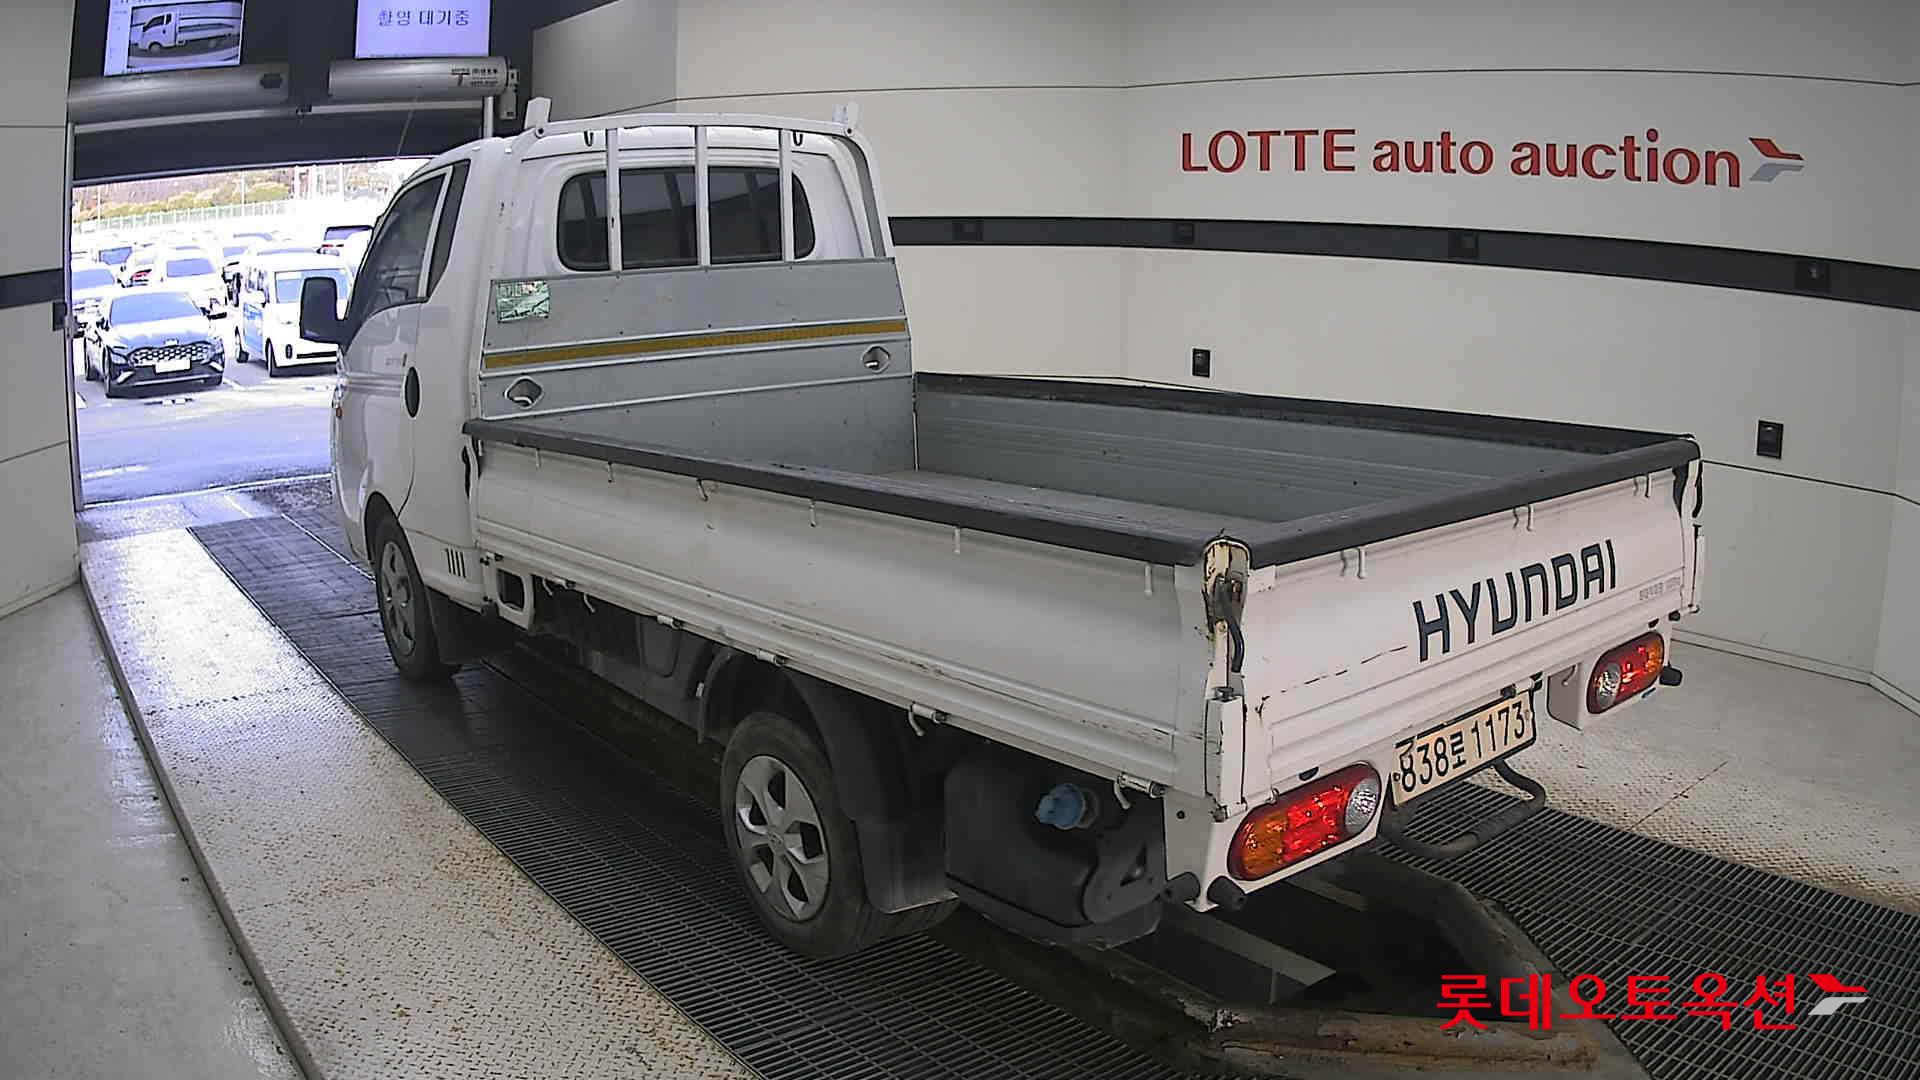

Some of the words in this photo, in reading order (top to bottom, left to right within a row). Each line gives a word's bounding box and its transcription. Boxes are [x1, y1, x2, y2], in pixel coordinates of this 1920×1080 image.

[419, 9, 470, 26] 대기중
[1181, 129, 1356, 172] LOTTE
[1373, 131, 1494, 175] auto
[1511, 128, 1741, 188] auction
[1412, 539, 1617, 663] HYUNDAI
[1398, 731, 1467, 793] 838로
[1471, 701, 1525, 759] 1173
